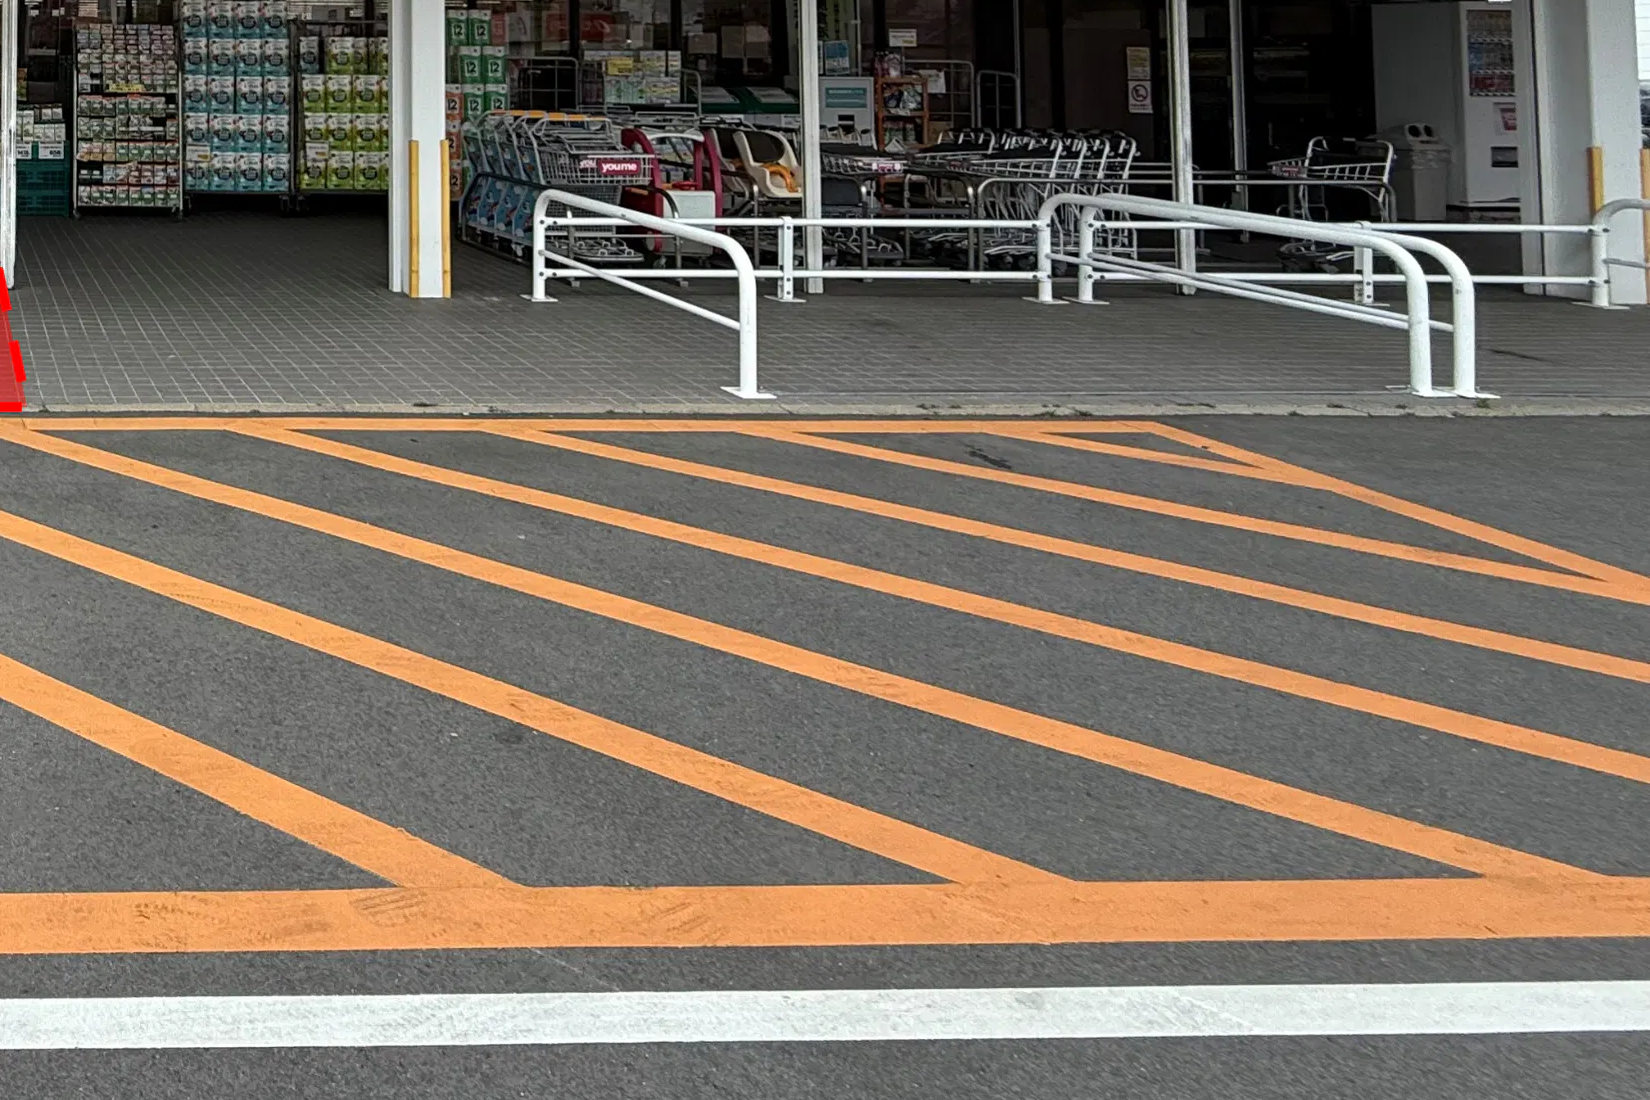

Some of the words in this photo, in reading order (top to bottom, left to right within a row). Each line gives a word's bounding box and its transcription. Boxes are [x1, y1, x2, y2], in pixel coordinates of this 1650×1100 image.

[465, 61, 476, 73] 12
[489, 61, 500, 73] 12
[470, 100, 479, 111] 12
[602, 163, 637, 173] youme
